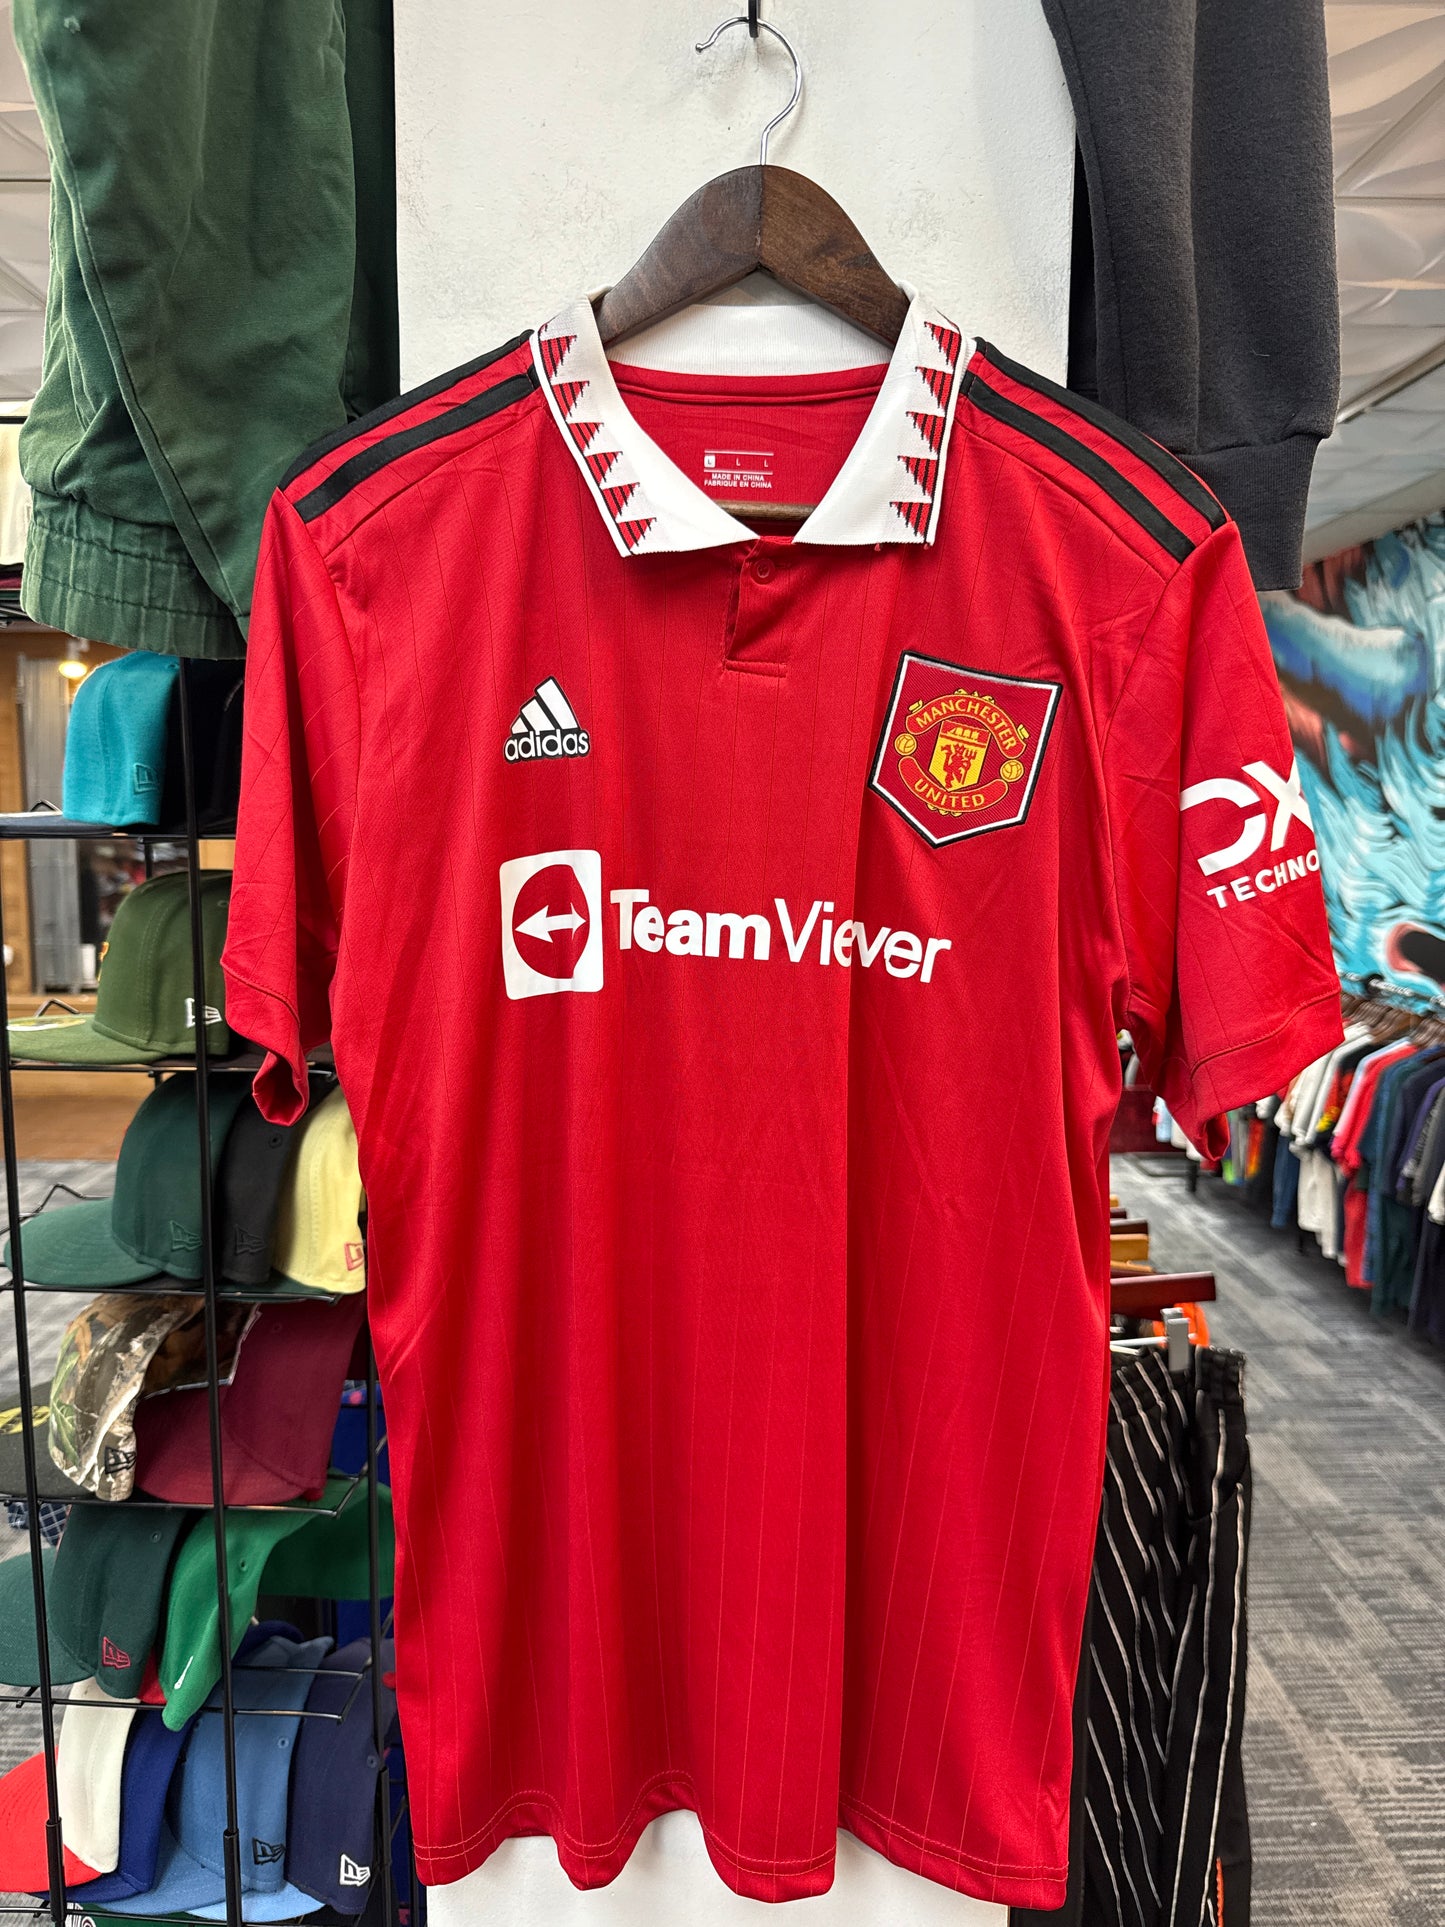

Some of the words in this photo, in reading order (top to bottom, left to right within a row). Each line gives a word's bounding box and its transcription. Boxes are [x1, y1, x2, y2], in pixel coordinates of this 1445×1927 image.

[504, 728, 590, 761] adidas
[915, 698, 1018, 751] MANCHESTER
[914, 778, 986, 809] UNITED
[1206, 849, 1320, 909] TECHNO
